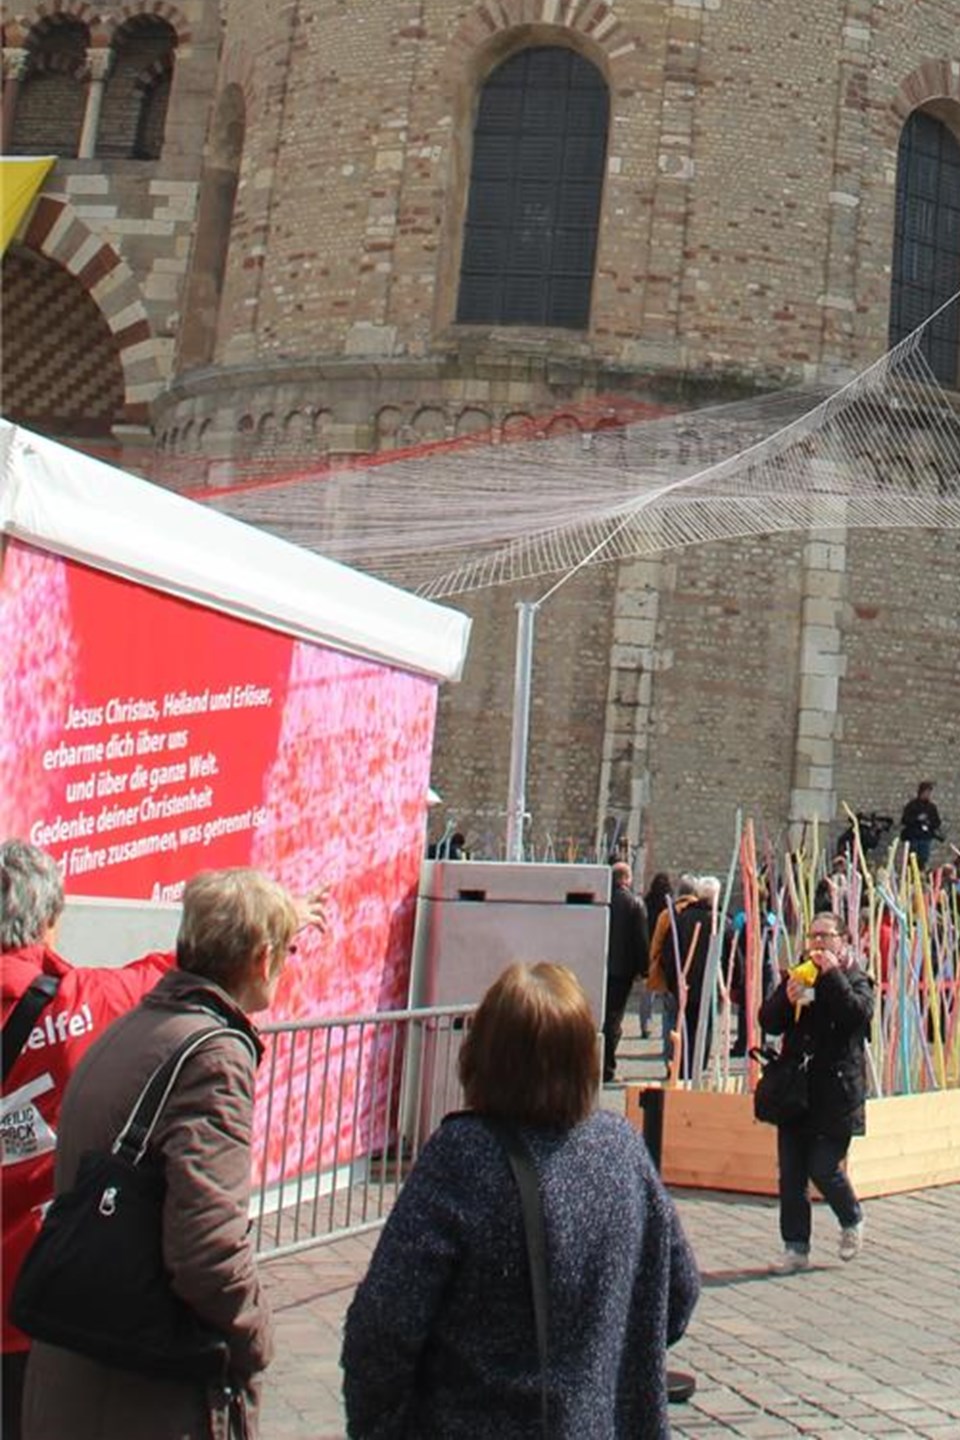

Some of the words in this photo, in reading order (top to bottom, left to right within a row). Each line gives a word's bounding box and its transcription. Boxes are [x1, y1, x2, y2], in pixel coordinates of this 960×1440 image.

[65, 705, 104, 730] Jesus
[105, 698, 160, 724] Christus,
[162, 687, 210, 717] Heiland
[209, 686, 233, 711] und
[232, 683, 273, 708] Erlöser,
[43, 739, 104, 770] erbarme
[105, 731, 135, 760] dich
[136, 728, 168, 756] über
[167, 729, 190, 749] uns
[65, 771, 96, 804] und
[96, 769, 128, 798] über
[129, 765, 149, 790] die
[149, 760, 187, 793] ganze
[29, 810, 96, 848] Gedenke
[95, 802, 140, 835] deiner
[139, 785, 214, 822] Christenheit
[68, 846, 112, 878] führe
[107, 831, 179, 867] zusammen,
[179, 824, 203, 847] was
[202, 810, 252, 847] getrennt
[21, 1002, 93, 1055] elfe!
